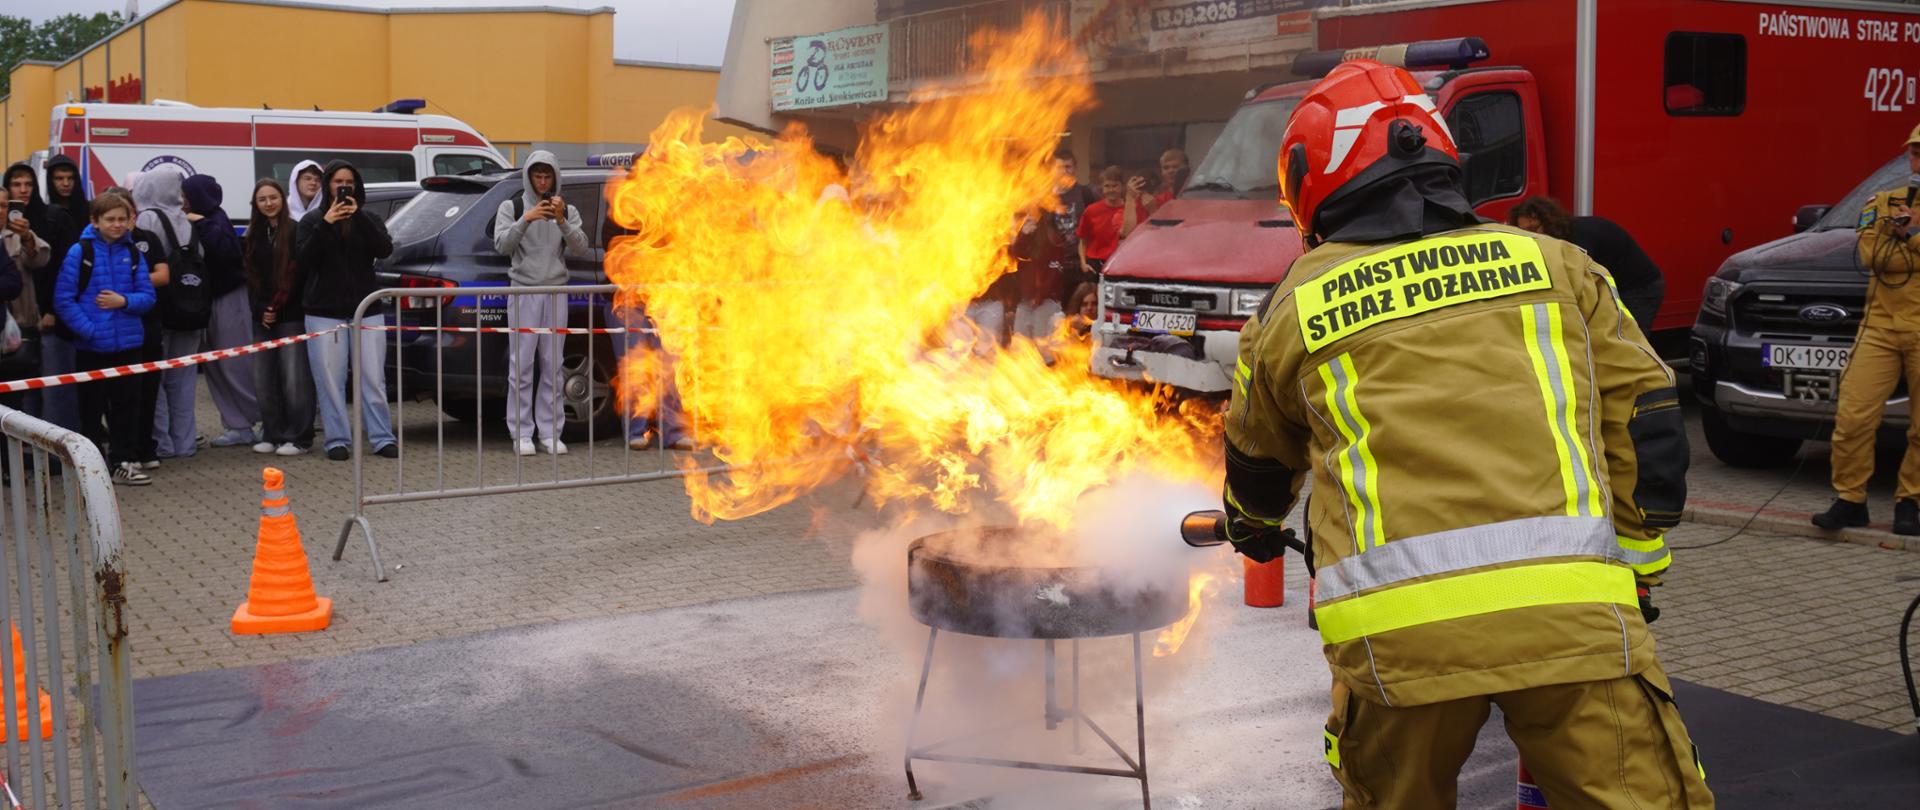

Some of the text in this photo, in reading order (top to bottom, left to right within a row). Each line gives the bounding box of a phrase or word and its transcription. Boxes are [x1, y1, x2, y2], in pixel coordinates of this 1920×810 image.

[1759, 10, 1850, 39] PAŃSTWOWA
[1857, 19, 1899, 42] STRAŻ
[601, 154, 631, 168] WOPR
[1322, 240, 1511, 304] PAŃSTWOWA
[1307, 261, 1542, 342] STRAŻ POŻARNA
[1138, 313, 1195, 331] OK 16520
[1774, 347, 1796, 366] OK
[1805, 348, 1848, 368] 1998
